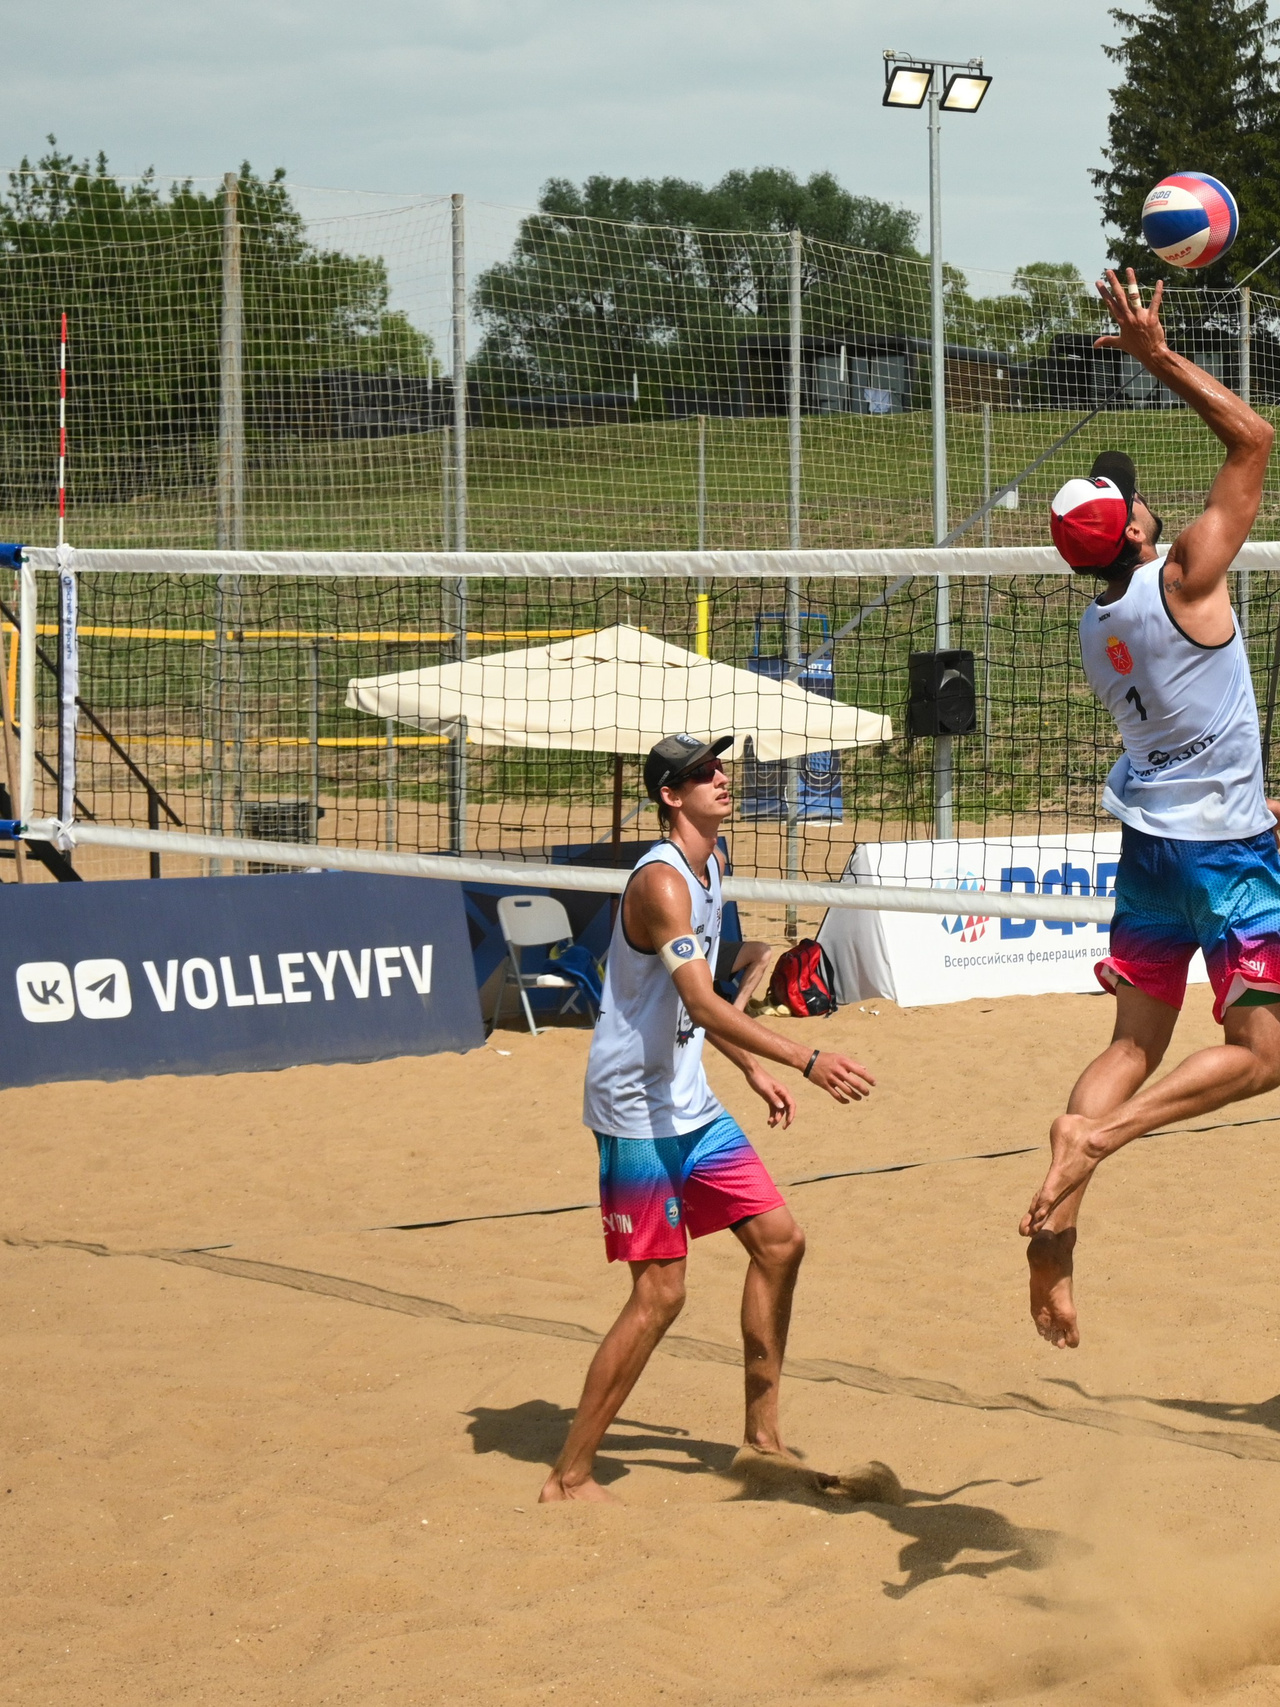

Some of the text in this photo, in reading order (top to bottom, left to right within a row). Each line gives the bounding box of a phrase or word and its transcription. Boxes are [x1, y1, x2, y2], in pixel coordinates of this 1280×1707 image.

[142, 944, 433, 1012] VOLLEYVFV
[944, 950, 1024, 969] Всероссийская
[1027, 949, 1087, 964] федерация
